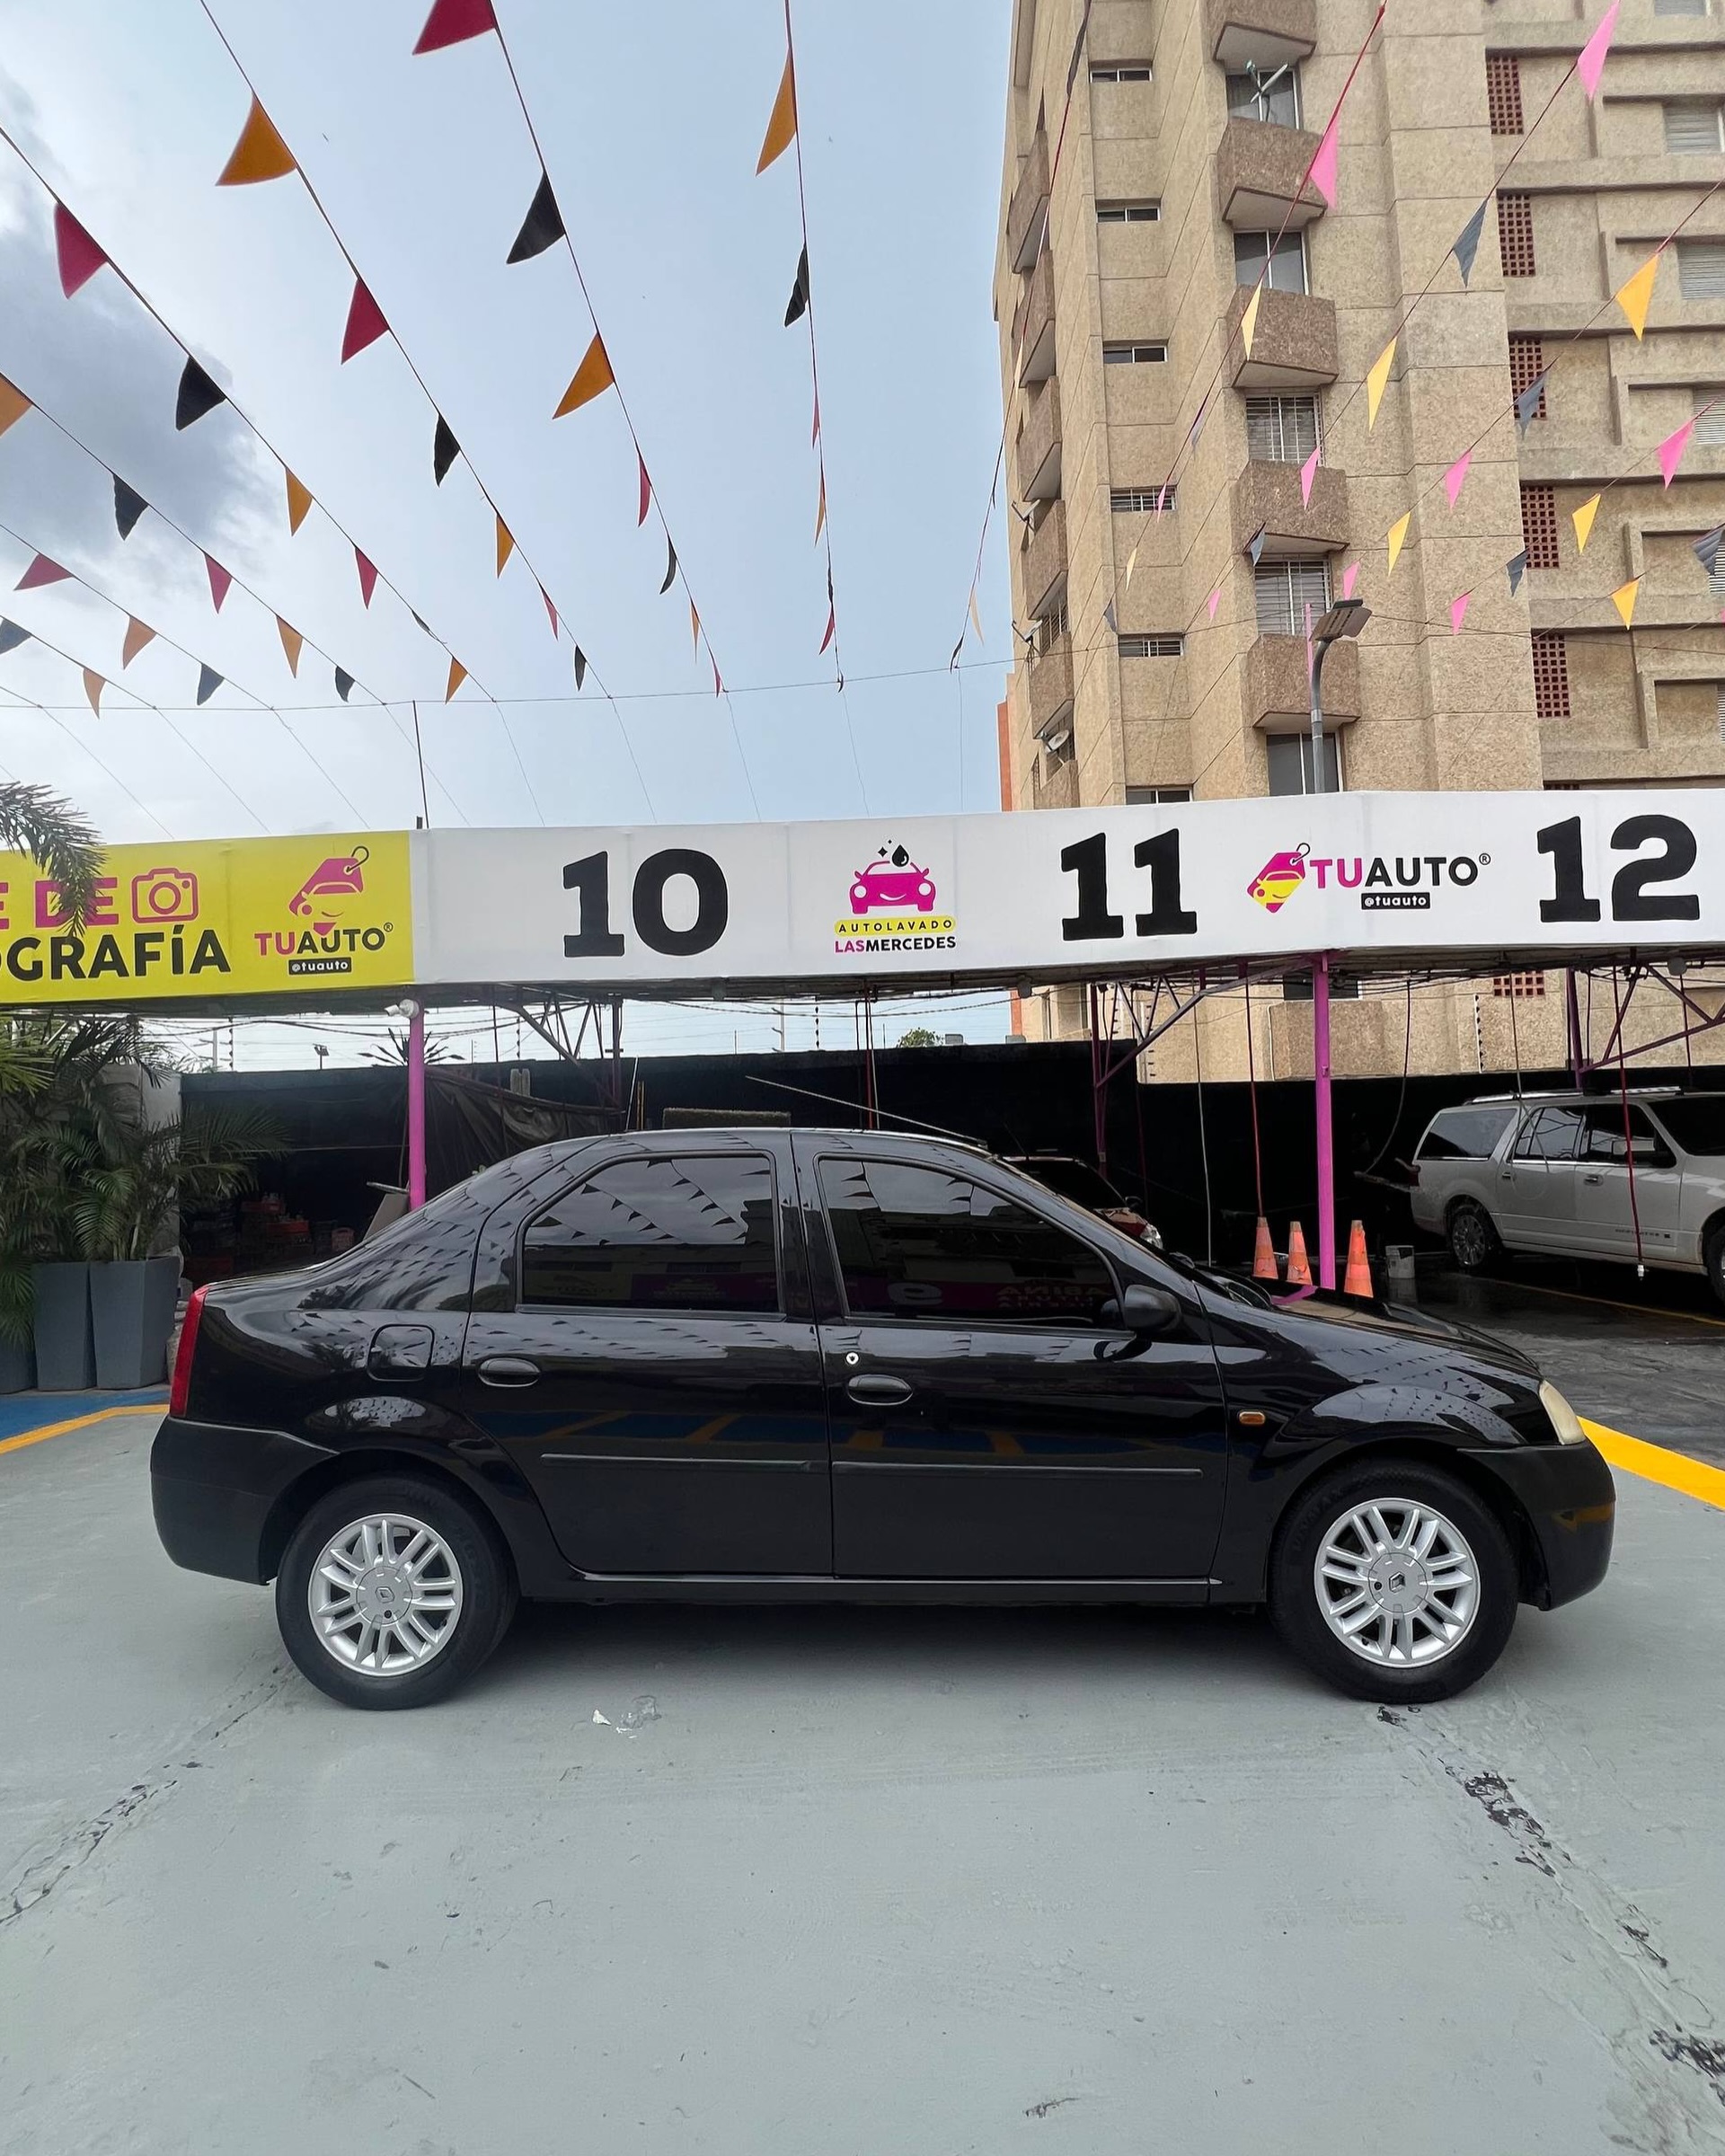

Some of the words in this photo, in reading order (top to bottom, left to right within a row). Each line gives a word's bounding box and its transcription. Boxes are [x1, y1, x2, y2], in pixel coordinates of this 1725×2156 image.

[1060, 827, 1198, 941] 11
[1536, 813, 1701, 923] 12
[35, 877, 119, 928] DE
[563, 848, 729, 958] 10
[838, 919, 952, 933] AUTOLAVADO
[1364, 895, 1427, 907] @tuauto
[0, 924, 231, 982] GRAFÍA
[291, 959, 349, 973] @tuauto
